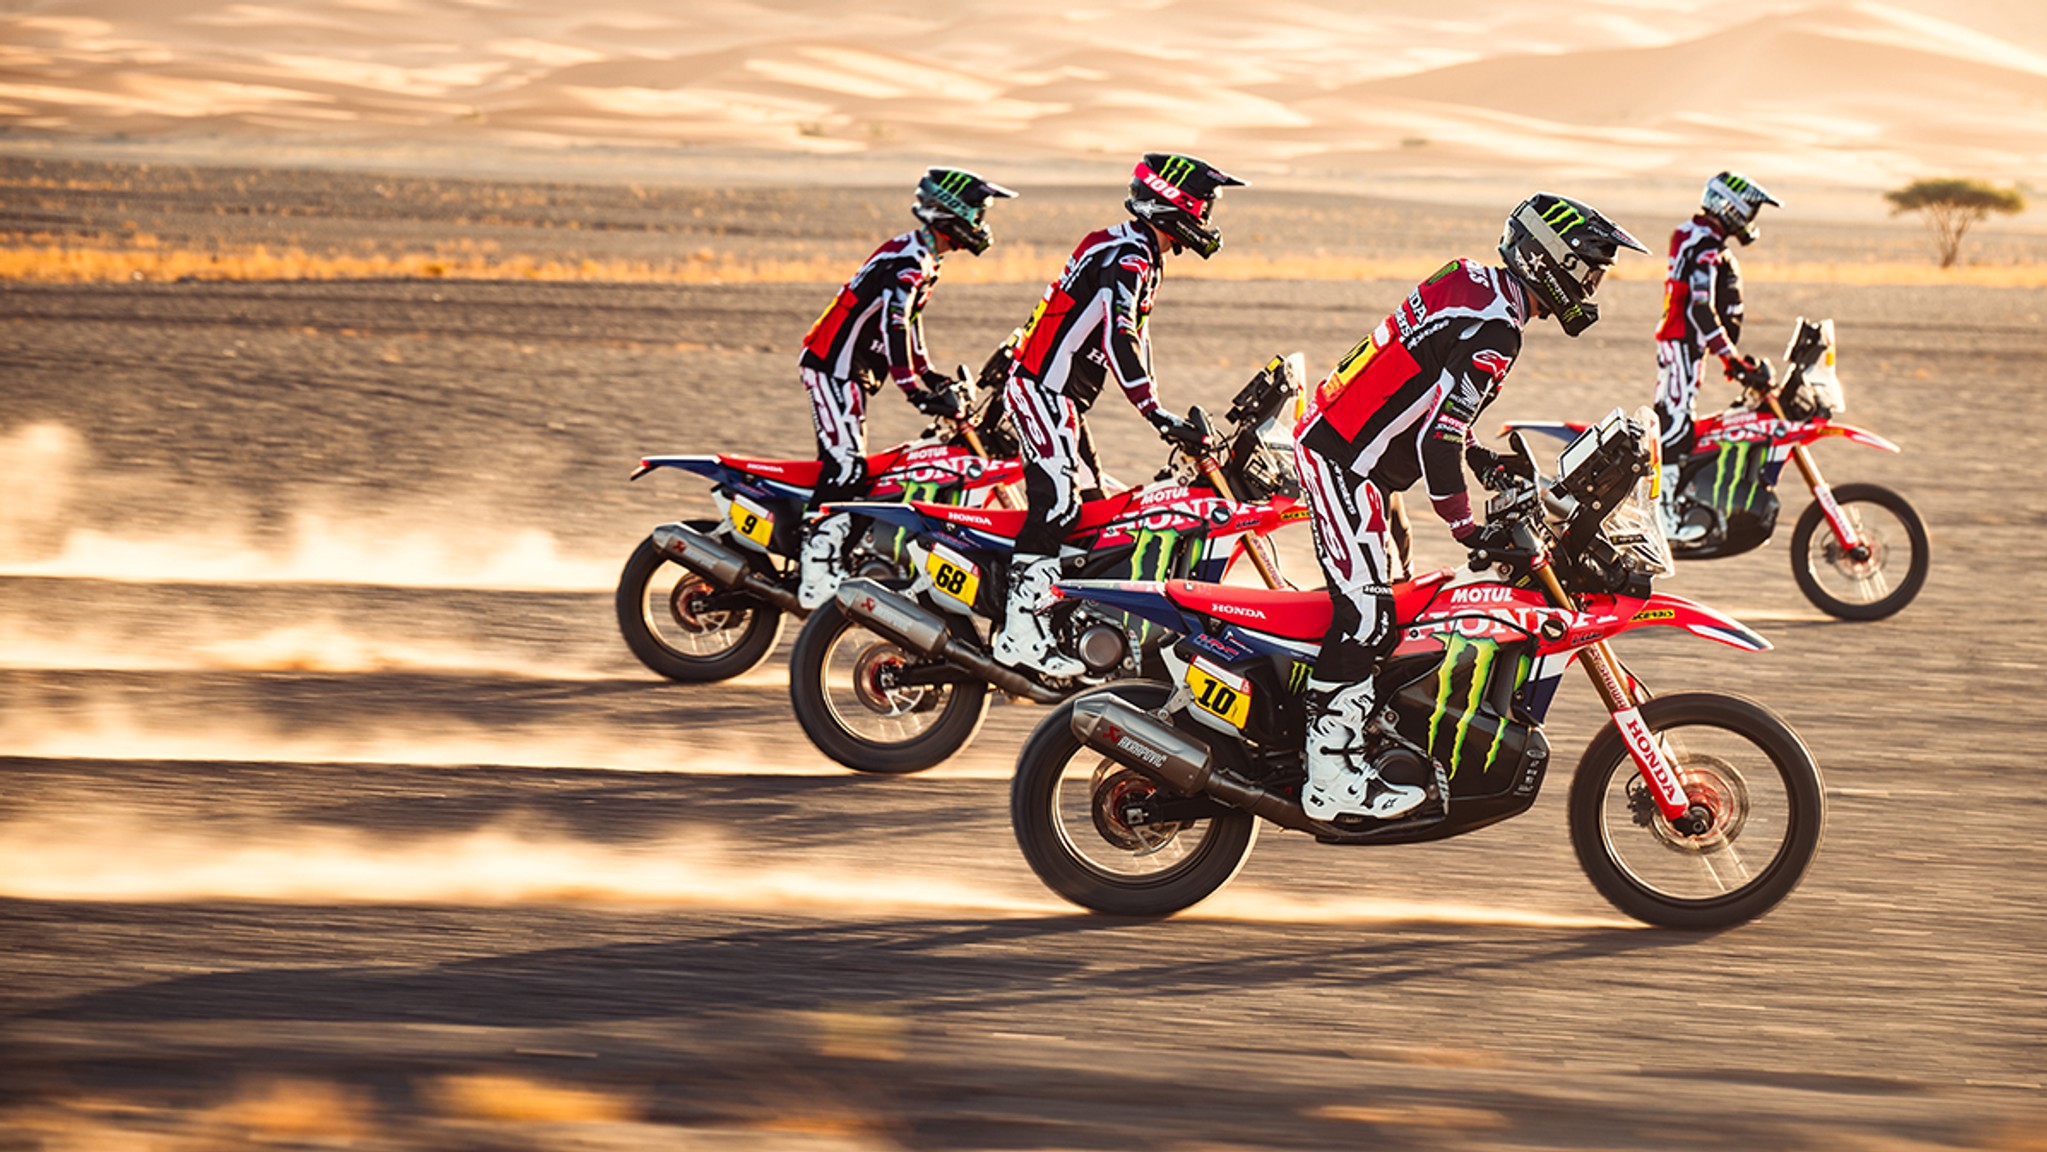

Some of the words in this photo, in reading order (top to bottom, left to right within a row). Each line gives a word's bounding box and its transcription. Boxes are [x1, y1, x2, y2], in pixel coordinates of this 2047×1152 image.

[1143, 171, 1197, 210] 100%
[907, 447, 948, 460] MOTUL
[747, 463, 784, 473] HONDA
[1141, 488, 1190, 505] MOTUL
[741, 514, 758, 535] 9
[948, 512, 992, 525] HONDA
[936, 563, 967, 595] 68
[1451, 587, 1513, 603] MOTUL
[1212, 603, 1266, 619] HONDA
[1197, 679, 1236, 716] 10
[1626, 719, 1676, 801] HONDA
